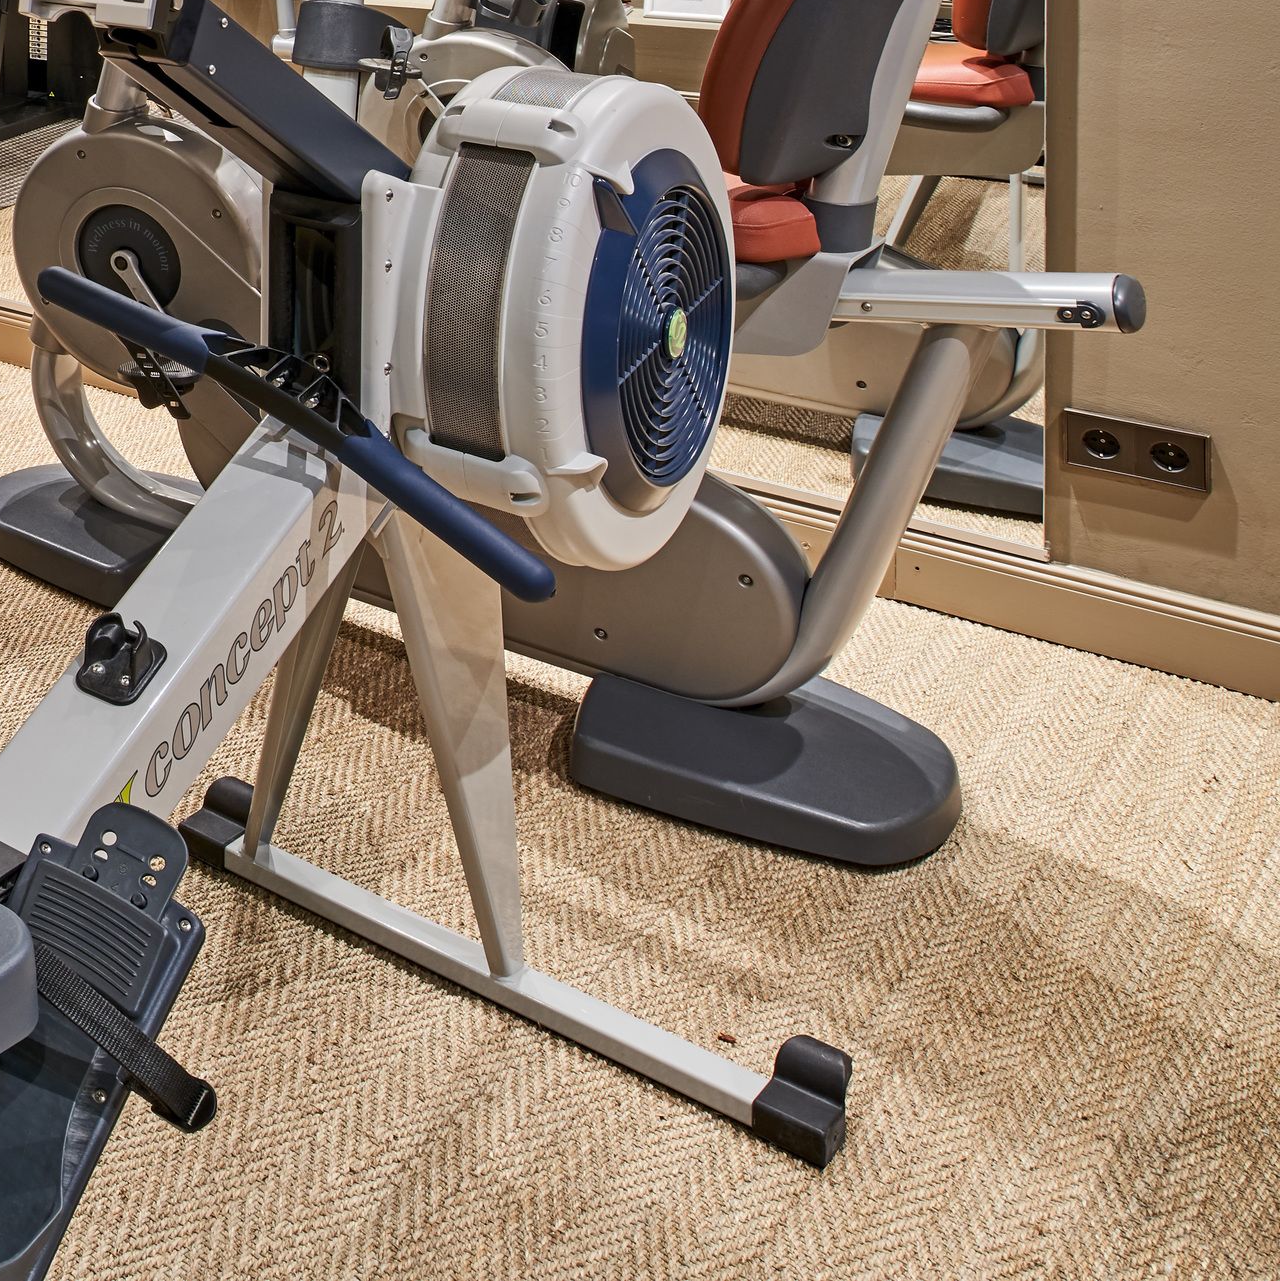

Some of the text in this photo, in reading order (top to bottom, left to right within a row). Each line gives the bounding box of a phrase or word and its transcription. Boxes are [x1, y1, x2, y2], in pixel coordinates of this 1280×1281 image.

[563, 171, 583, 188] 10
[548, 226, 564, 243] 8
[87, 217, 170, 272] Wellness in motion
[542, 255, 558, 273] 7
[537, 289, 552, 306] 6
[534, 321, 549, 339] 5
[532, 354, 549, 372] 4
[534, 385, 548, 403] 3
[535, 417, 551, 434] 2
[144, 499, 343, 798] concept 2
